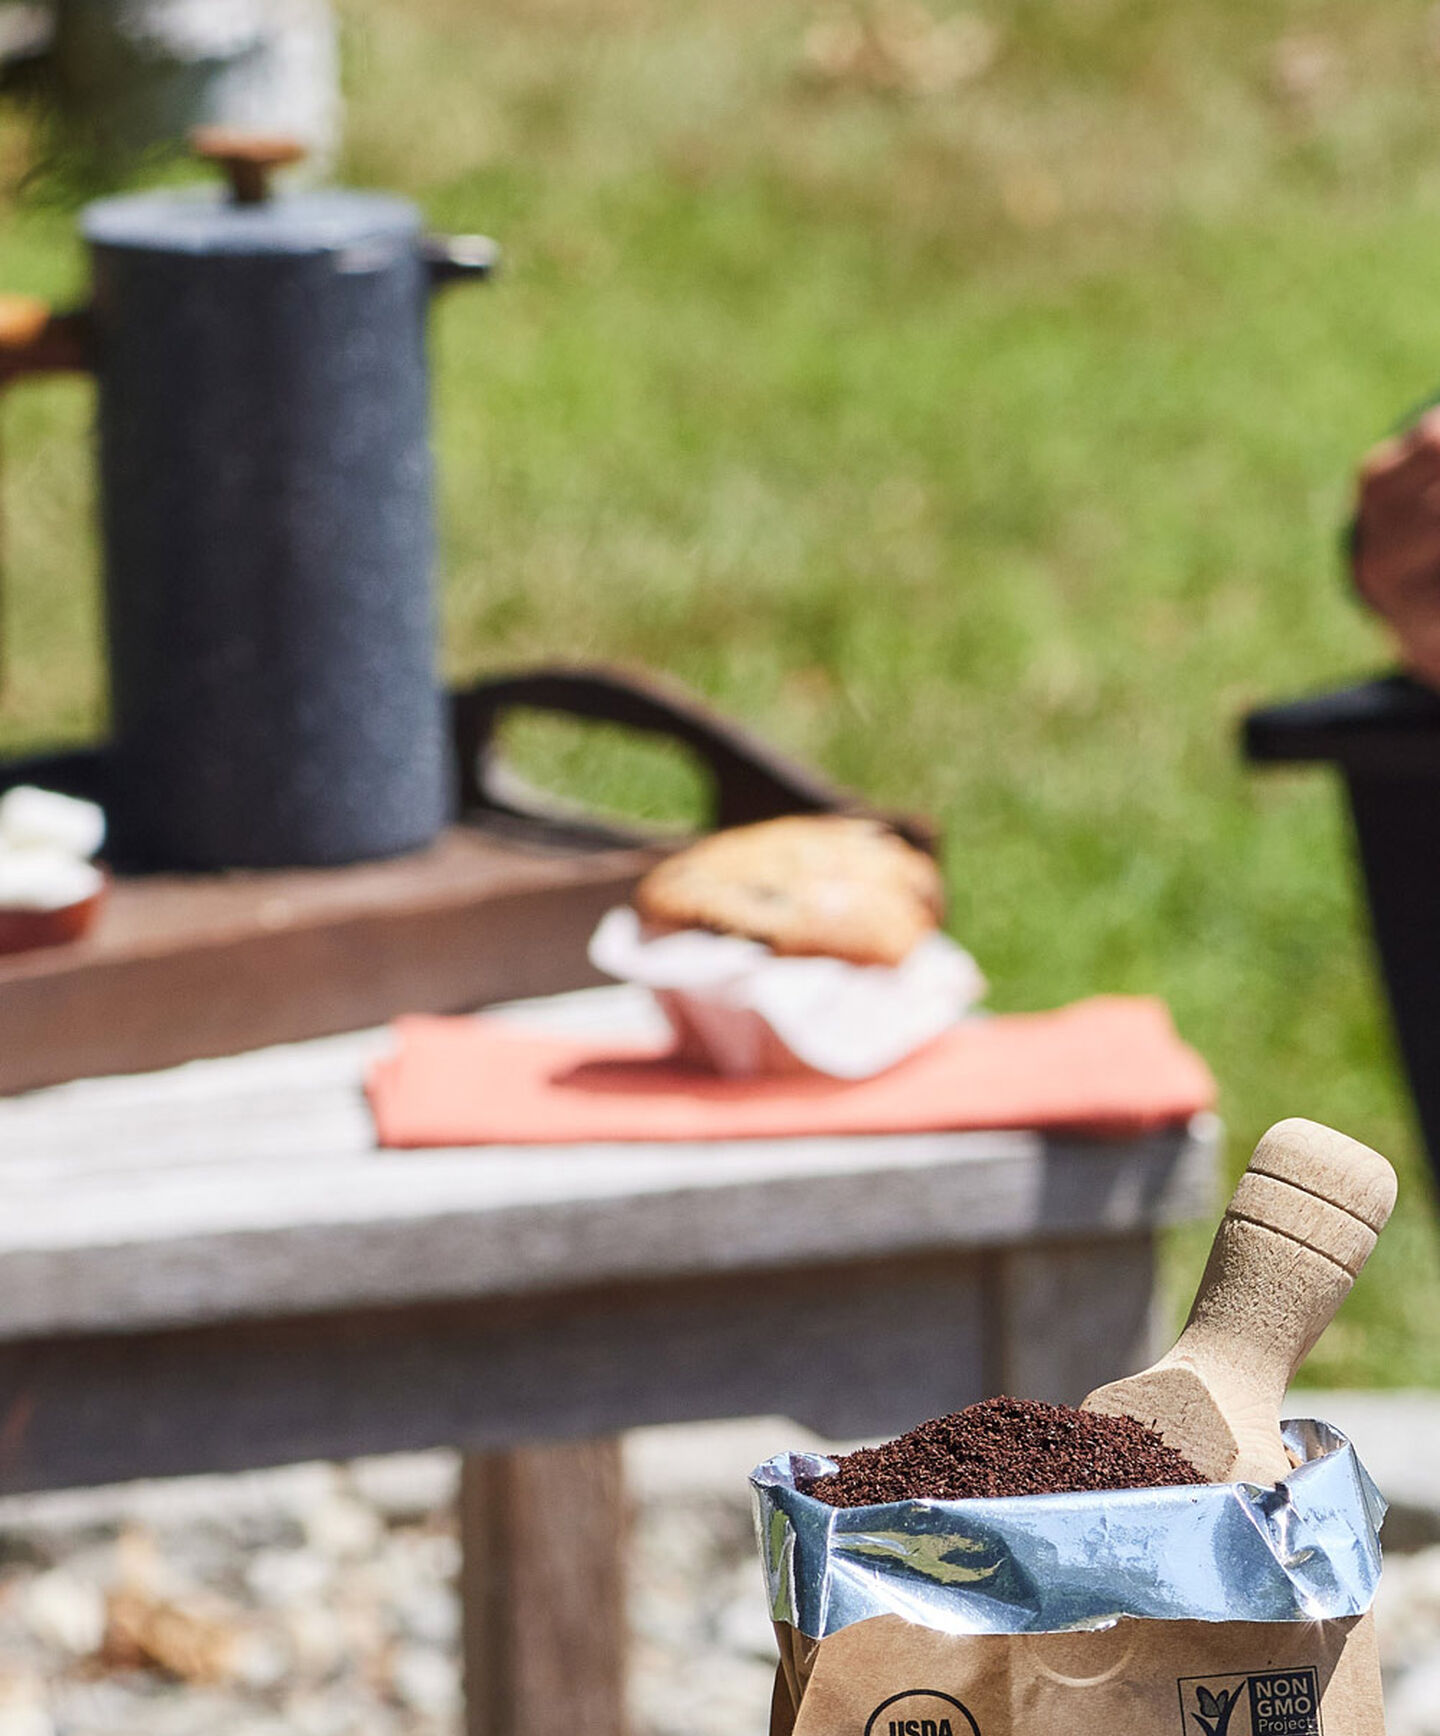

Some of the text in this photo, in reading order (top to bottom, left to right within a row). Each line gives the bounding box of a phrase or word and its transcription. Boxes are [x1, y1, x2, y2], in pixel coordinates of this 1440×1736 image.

[1255, 1677, 1309, 1699] NON
[1256, 1696, 1312, 1718] GMO
[1258, 1716, 1313, 1735] Project
